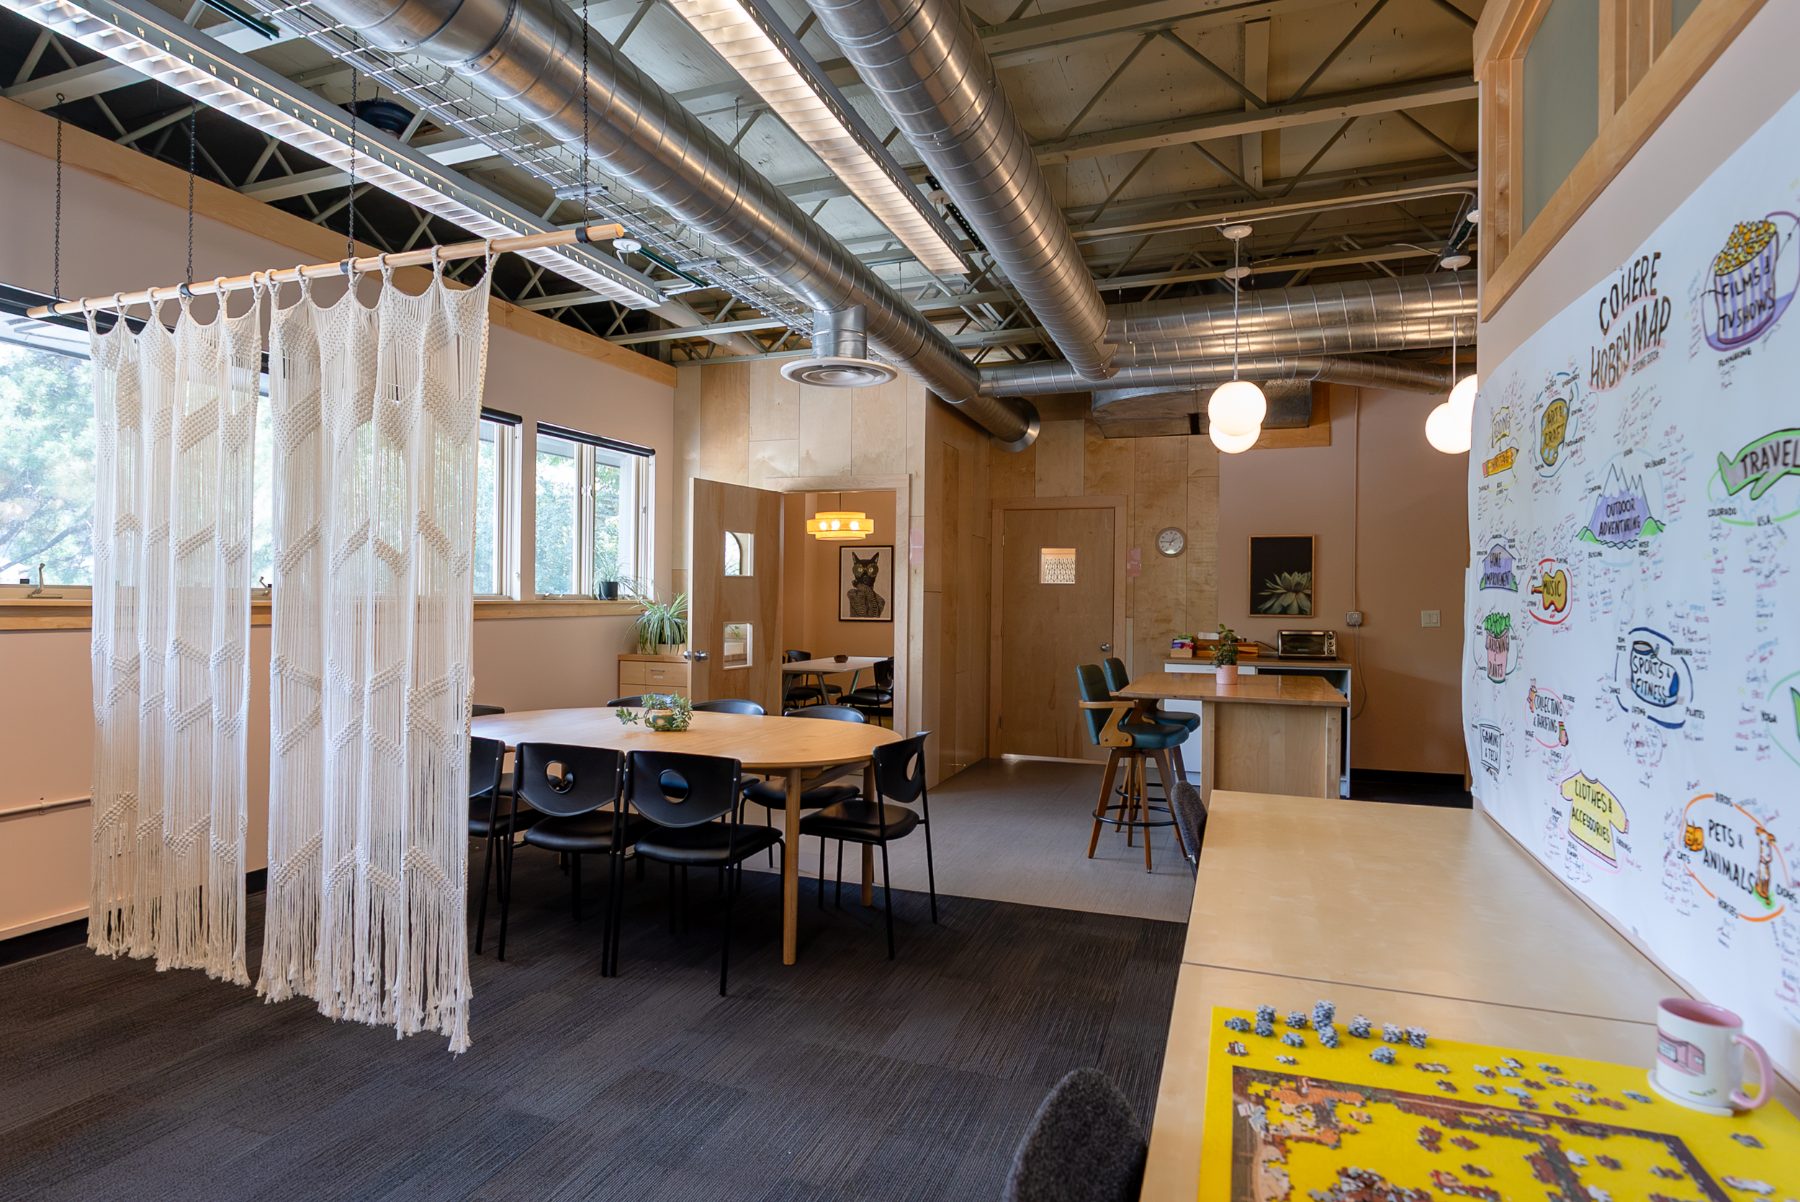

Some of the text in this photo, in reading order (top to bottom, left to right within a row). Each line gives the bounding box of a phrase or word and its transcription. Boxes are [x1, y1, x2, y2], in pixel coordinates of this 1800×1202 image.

[1599, 251, 1662, 336] COHERE
[1721, 266, 1761, 304] FILMS
[1719, 287, 1777, 333] TV SHOWS
[1590, 320, 1631, 390] HOBBY
[1633, 296, 1671, 360] MAP
[1740, 439, 1800, 480] TRAVEL
[1606, 498, 1636, 519] OUTDOOR
[1543, 579, 1562, 598] MUSIC
[1632, 655, 1664, 680] SPORTS
[1534, 693, 1563, 717] COLLECTING
[1636, 678, 1668, 705] FITNESS
[1482, 729, 1499, 748] GAMING
[1574, 779, 1607, 813] CLOTHES
[1571, 806, 1611, 844] ACCESSORIES
[1708, 818, 1735, 848] PETS
[1703, 845, 1754, 895] ANIMALS
